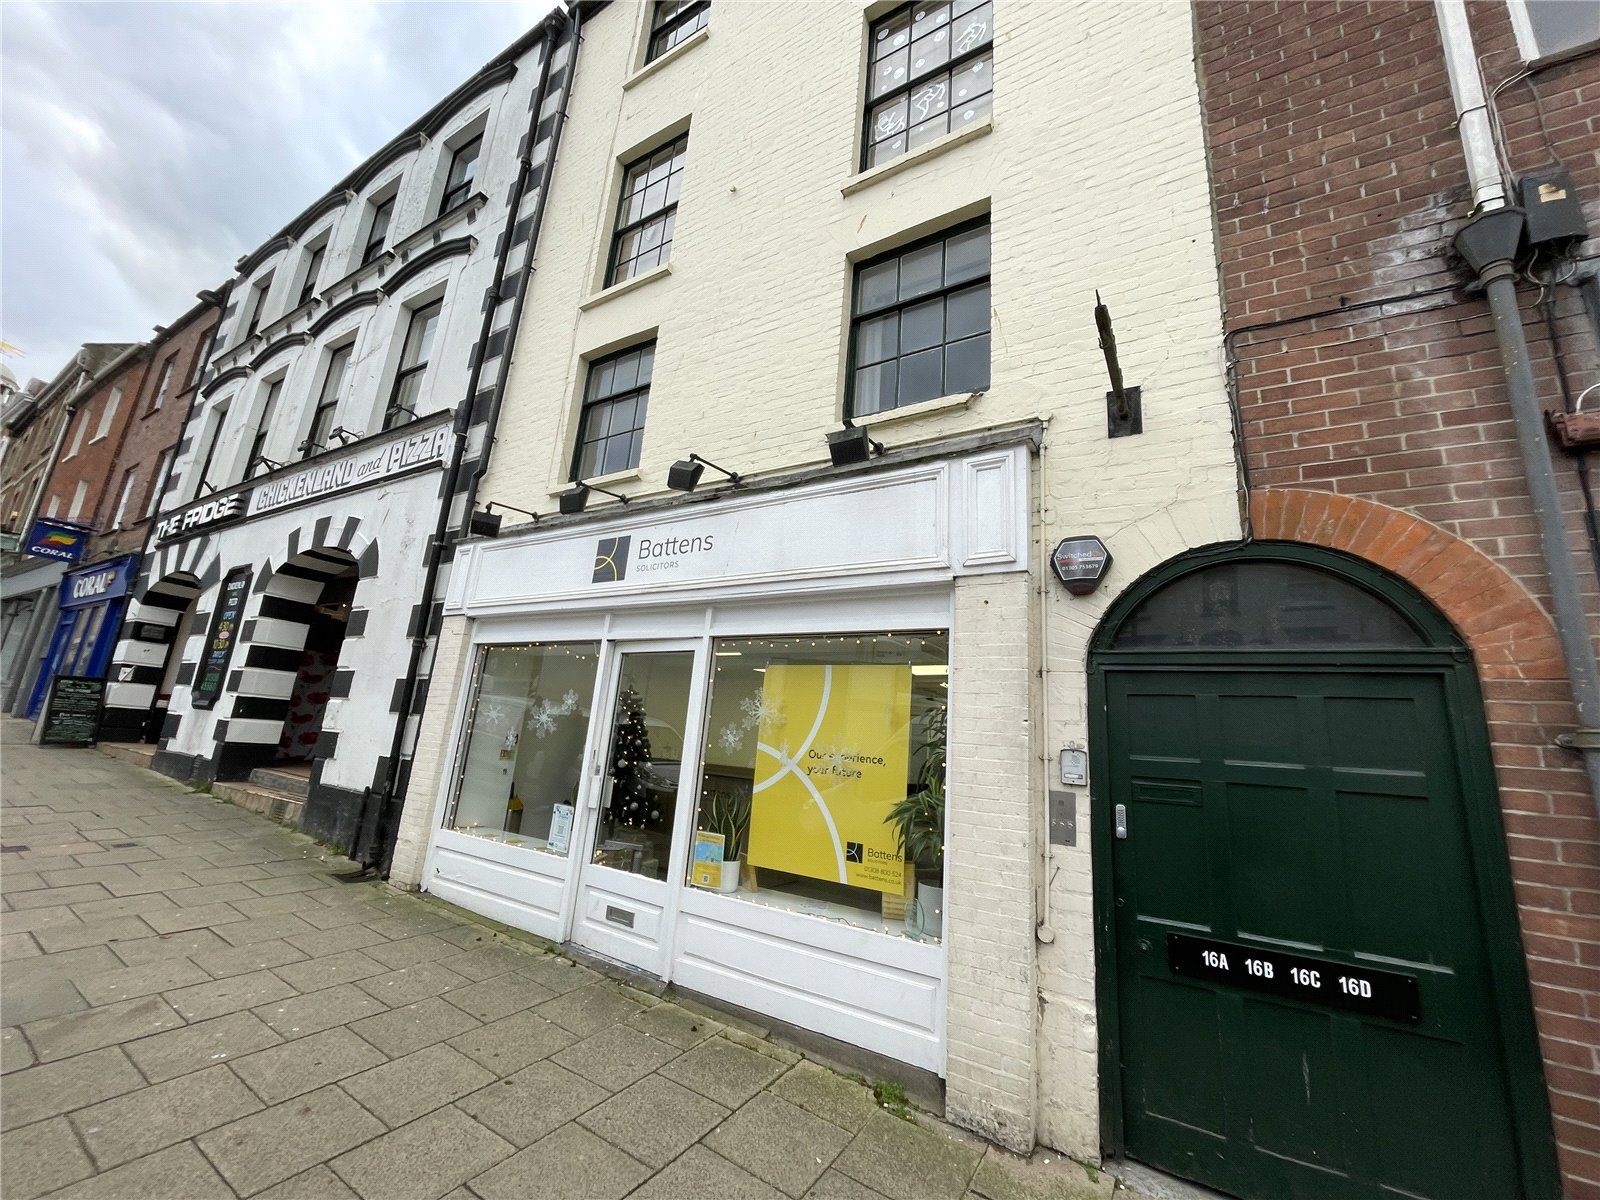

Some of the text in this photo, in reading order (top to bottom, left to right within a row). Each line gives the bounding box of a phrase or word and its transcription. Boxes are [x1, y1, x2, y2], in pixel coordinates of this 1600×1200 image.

[256, 427, 449, 511] CHICKENLAND and PIZZA
[156, 493, 242, 541] THE FRIDGE
[31, 546, 73, 559] CORAL
[638, 534, 714, 560] Battens
[636, 561, 679, 573] SOLICITORS
[73, 572, 107, 599] CORAL
[808, 749, 886, 767] Our eerience,
[867, 847, 903, 863] Battens
[1202, 950, 1372, 998] 16A 16B 16C 16D
